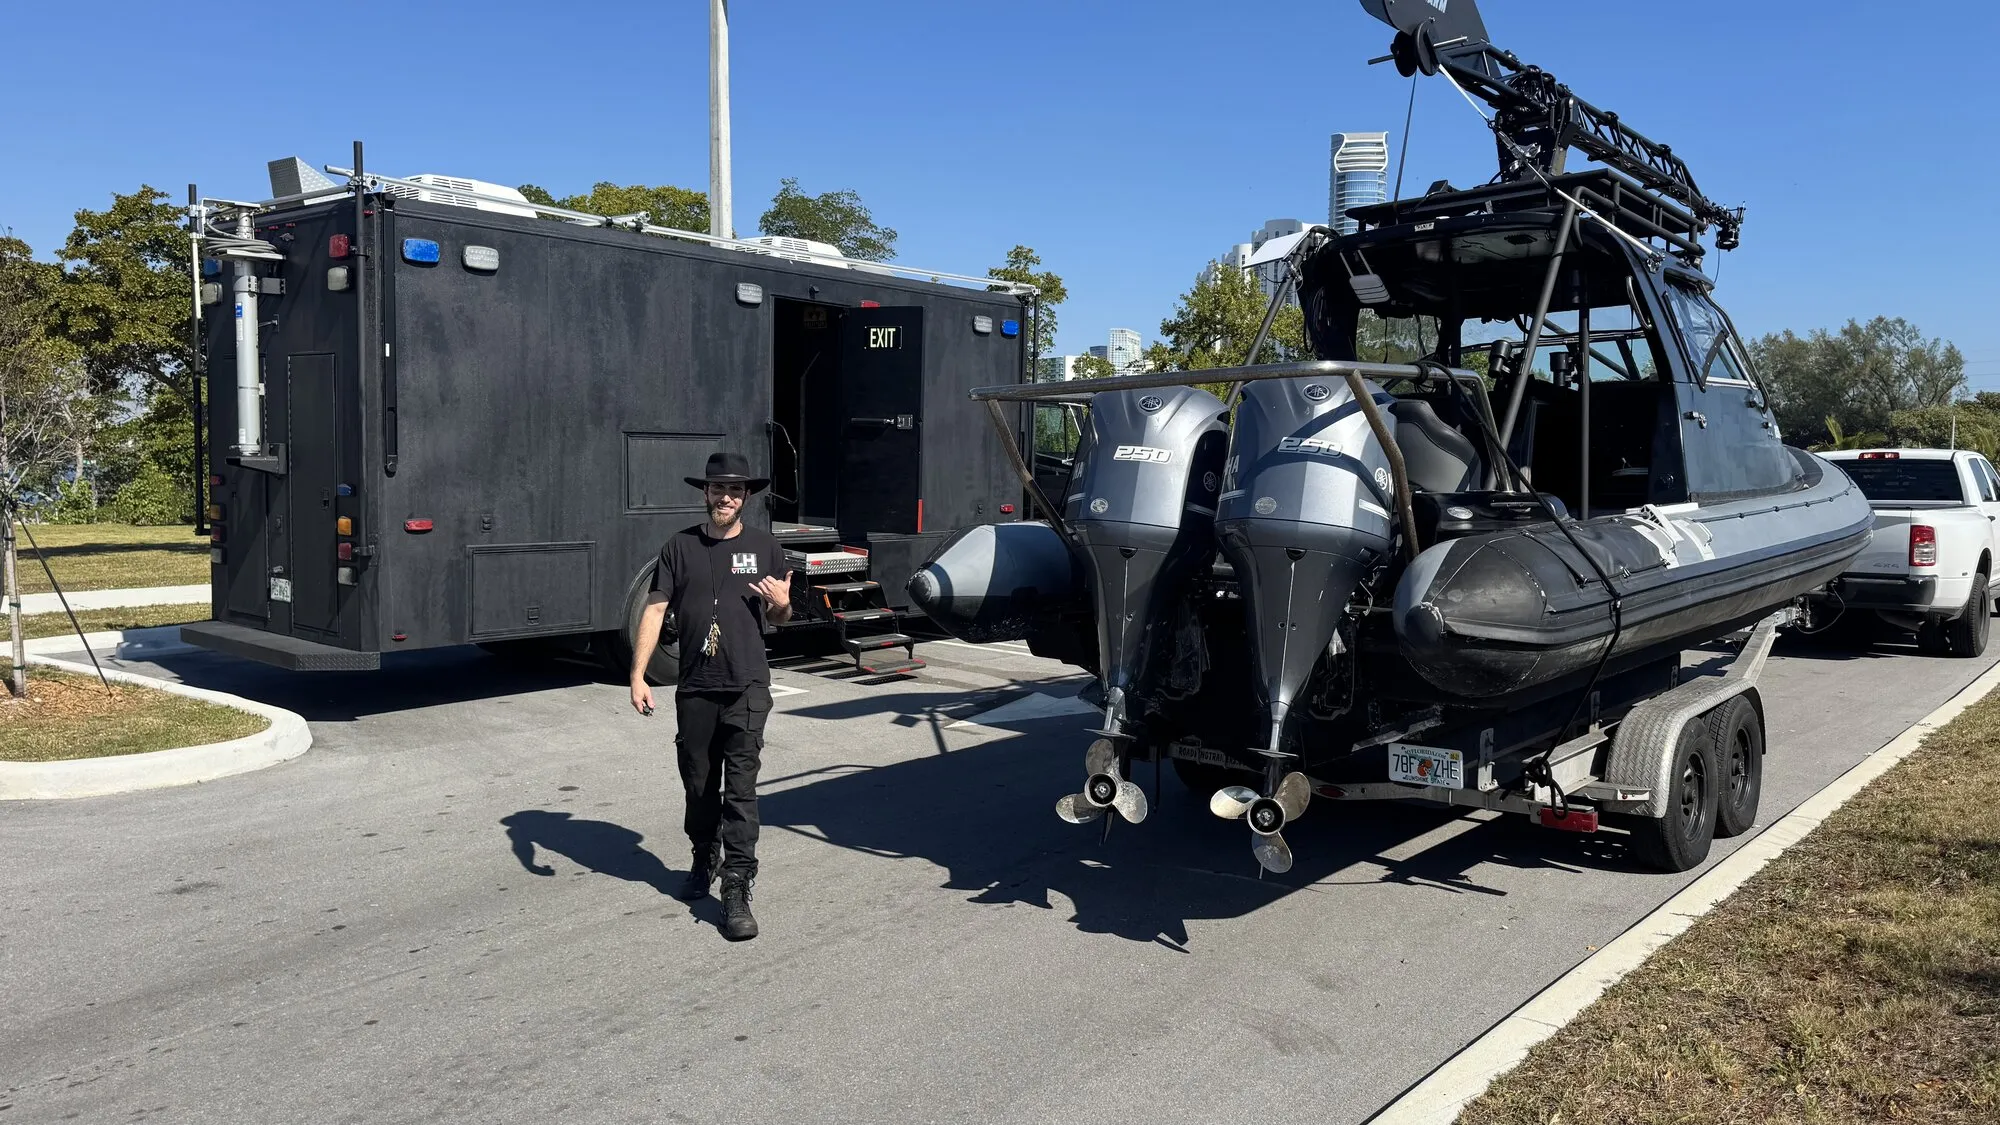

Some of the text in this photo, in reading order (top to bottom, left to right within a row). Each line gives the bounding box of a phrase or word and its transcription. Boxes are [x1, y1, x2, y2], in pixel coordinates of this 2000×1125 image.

[870, 327, 897, 348] EXIT
[1113, 445, 1174, 464] 250
[1278, 436, 1344, 458] 250
[732, 553, 757, 567] LH
[1392, 754, 1460, 780] 78F ZHE
